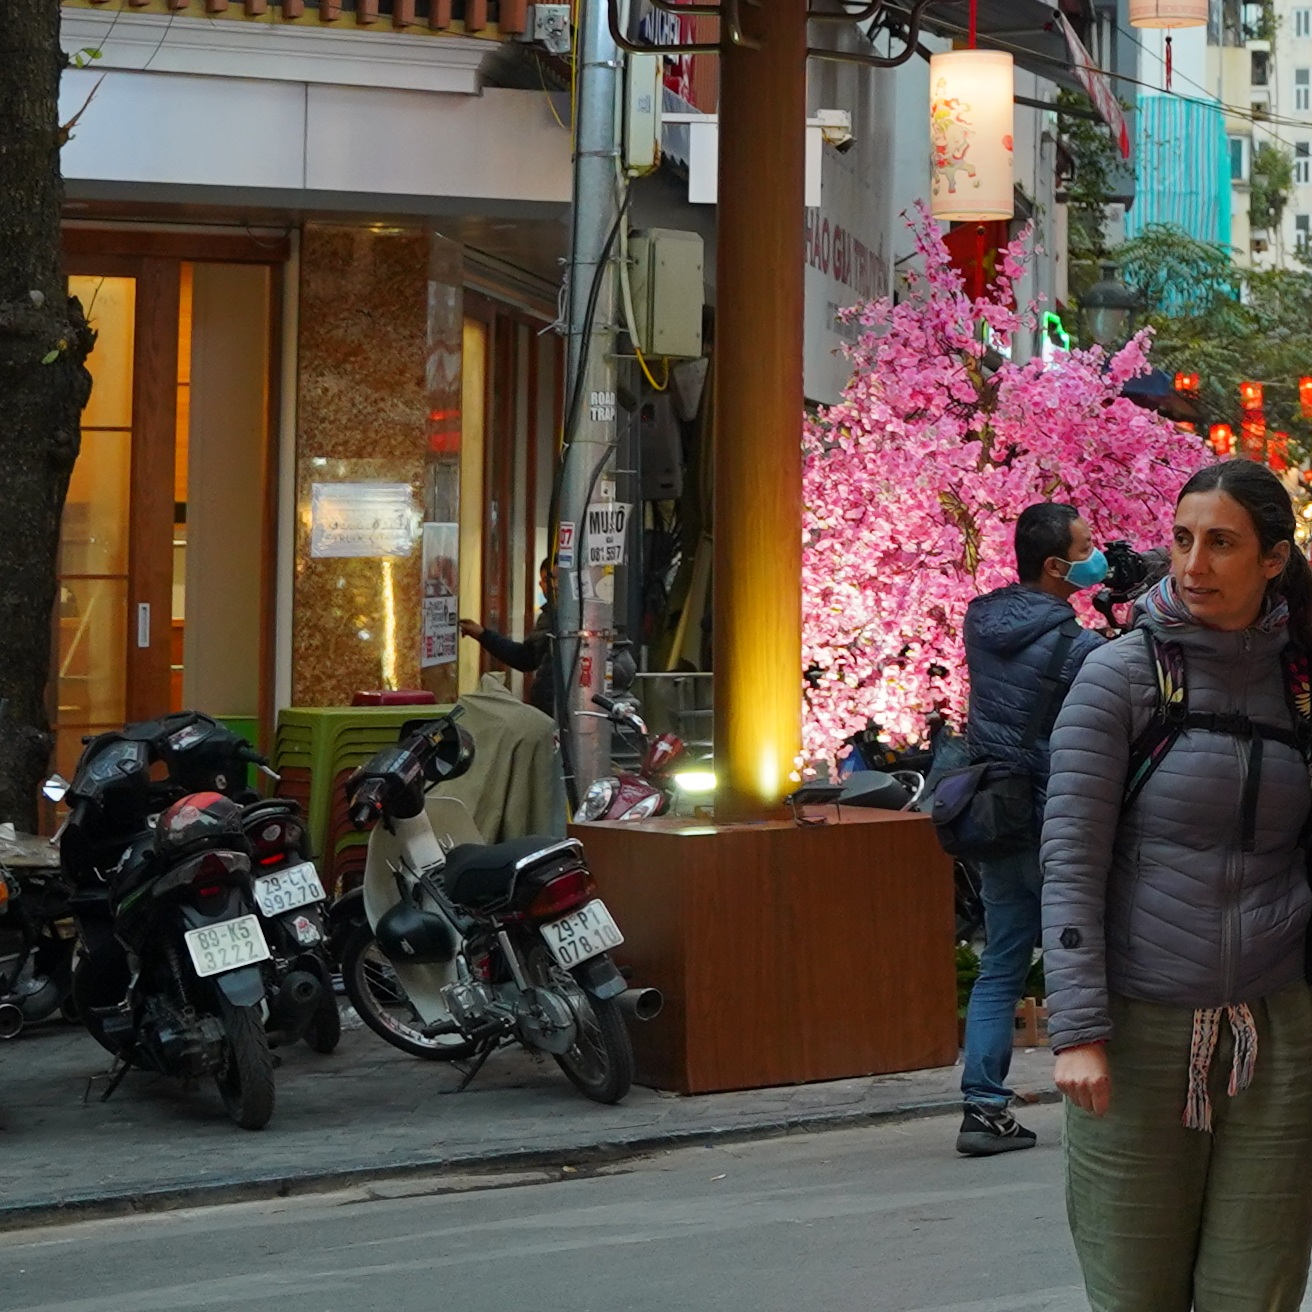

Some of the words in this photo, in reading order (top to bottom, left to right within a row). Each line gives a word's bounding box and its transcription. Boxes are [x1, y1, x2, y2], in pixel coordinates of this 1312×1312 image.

[590, 407, 615, 422] TRAP
[591, 391, 615, 406] ROAD
[198, 918, 250, 951] 89-K5
[552, 907, 601, 943] 29-P1
[204, 940, 259, 971] 3222
[558, 924, 617, 964] 078.10
